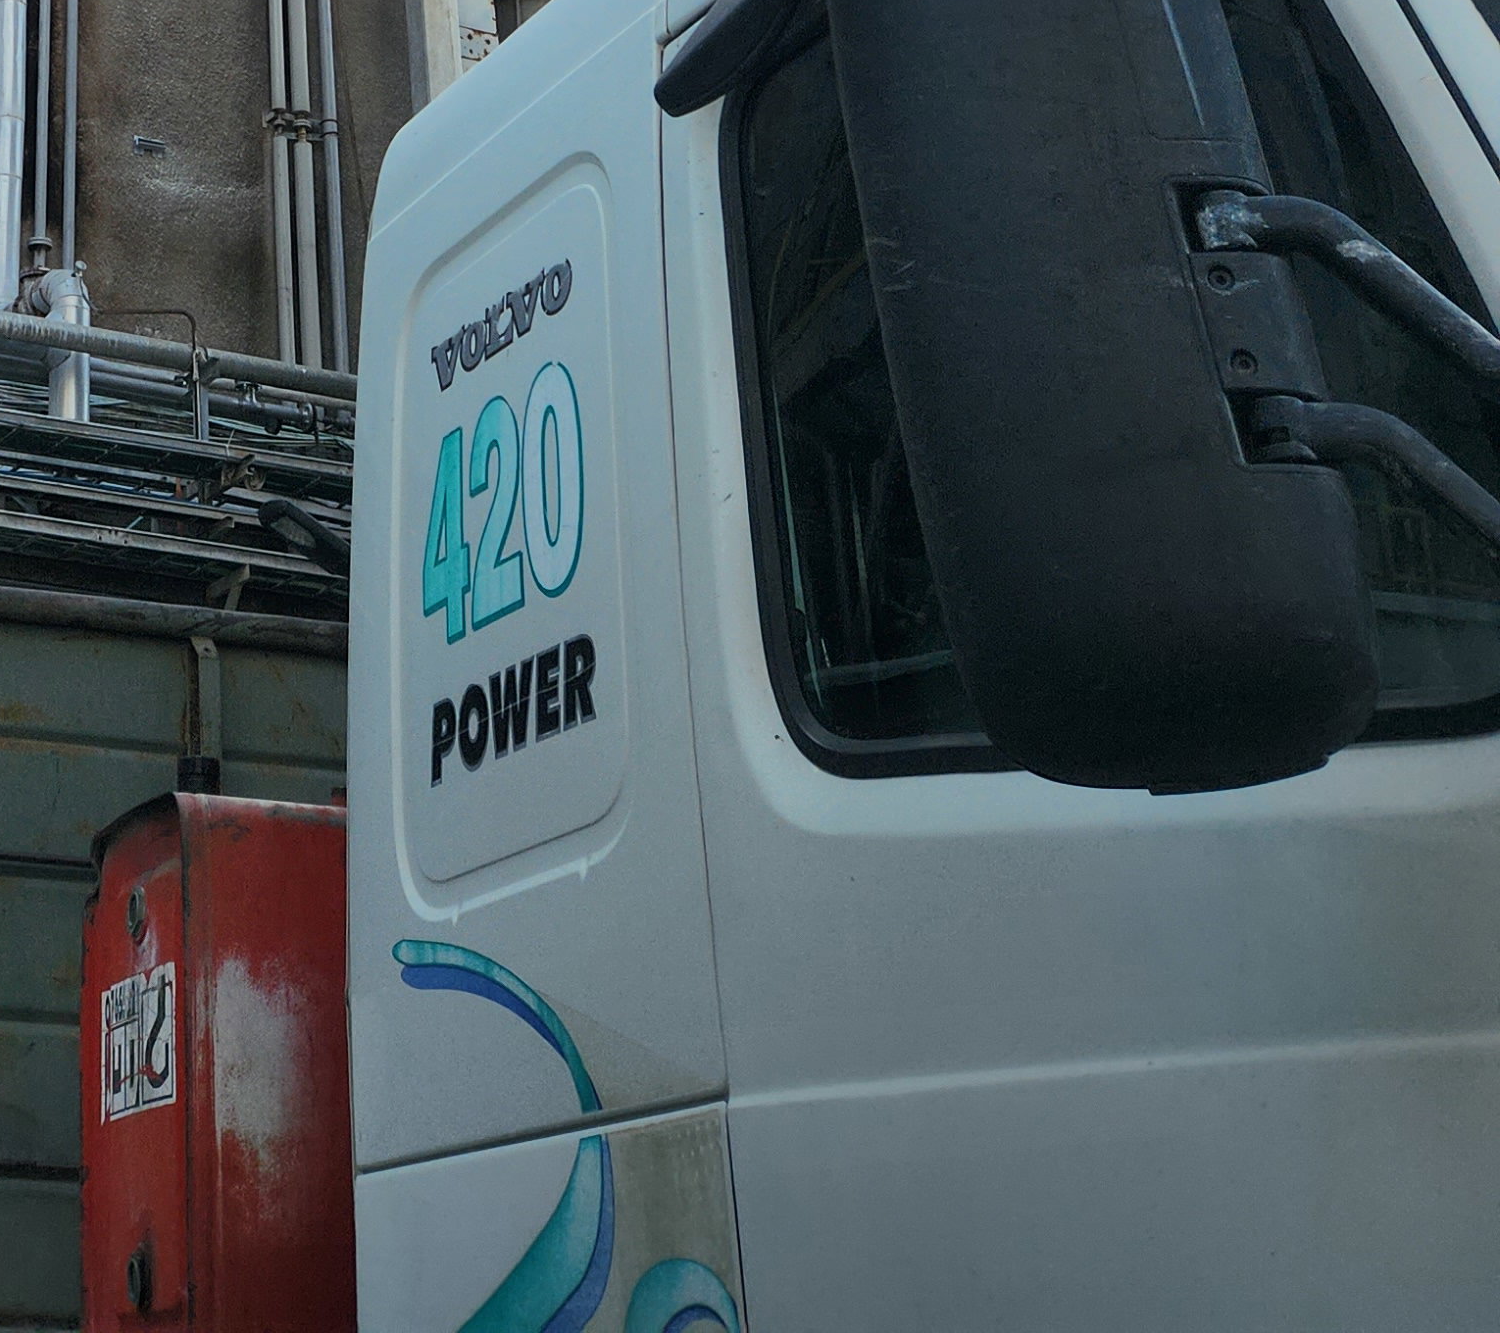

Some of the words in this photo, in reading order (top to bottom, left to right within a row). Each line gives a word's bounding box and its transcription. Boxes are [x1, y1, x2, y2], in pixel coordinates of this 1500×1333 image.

[431, 258, 572, 392] VOLVO
[422, 362, 584, 645] 420
[430, 633, 597, 788] POWER
